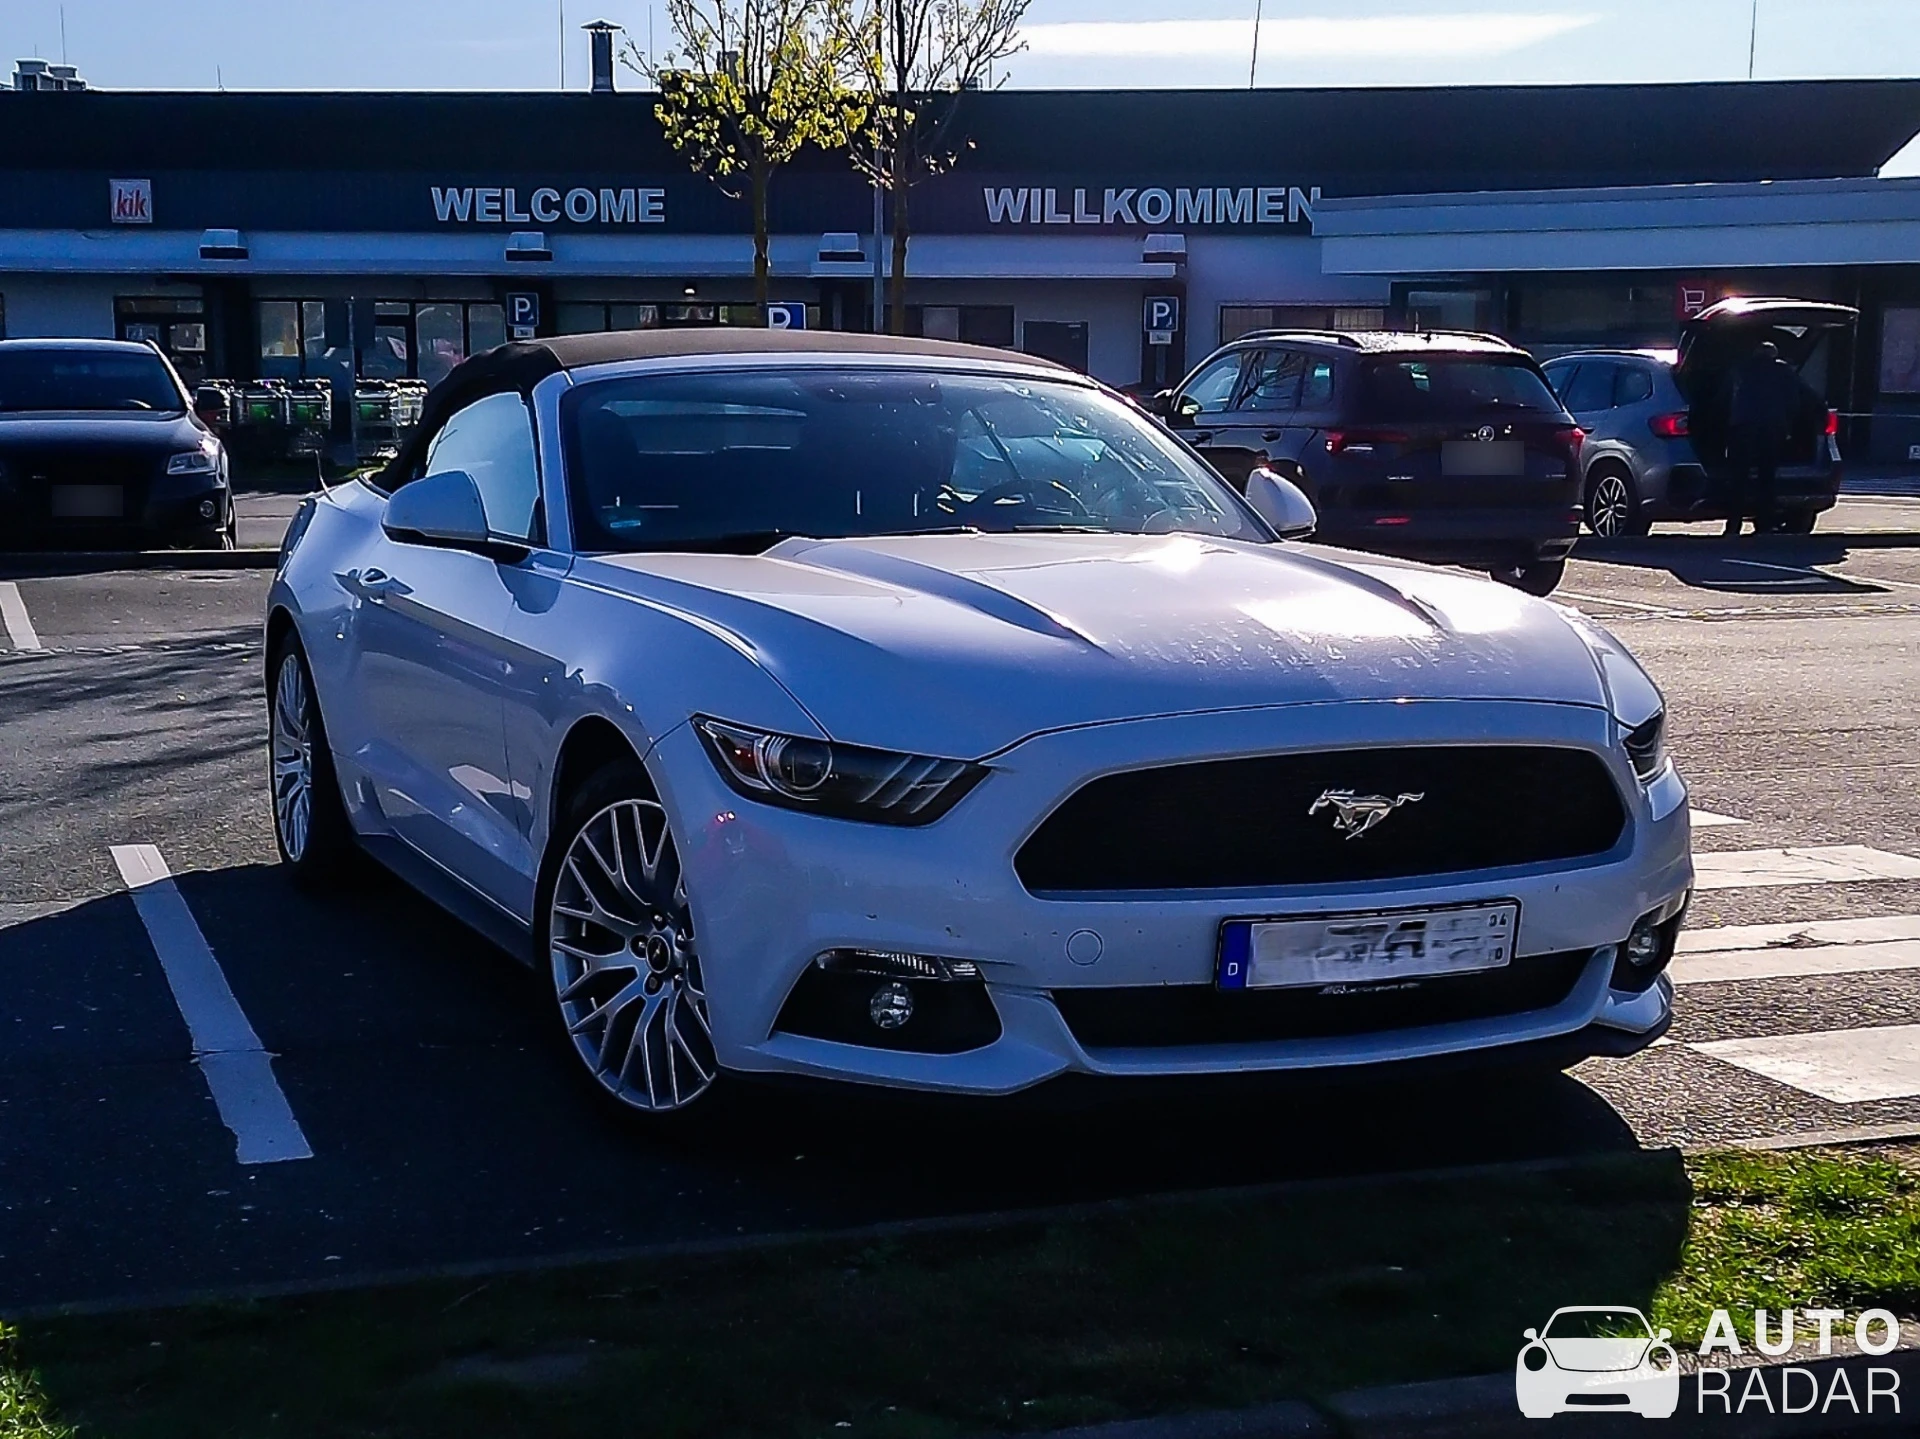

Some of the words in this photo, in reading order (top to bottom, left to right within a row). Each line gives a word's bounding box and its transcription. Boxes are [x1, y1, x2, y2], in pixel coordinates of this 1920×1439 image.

[116, 187, 147, 218] kik
[431, 187, 665, 222] WELCOME
[984, 187, 1321, 224] WILLKOMMEN
[514, 297, 531, 322] P
[1152, 302, 1170, 327] P
[1227, 962, 1238, 976] D
